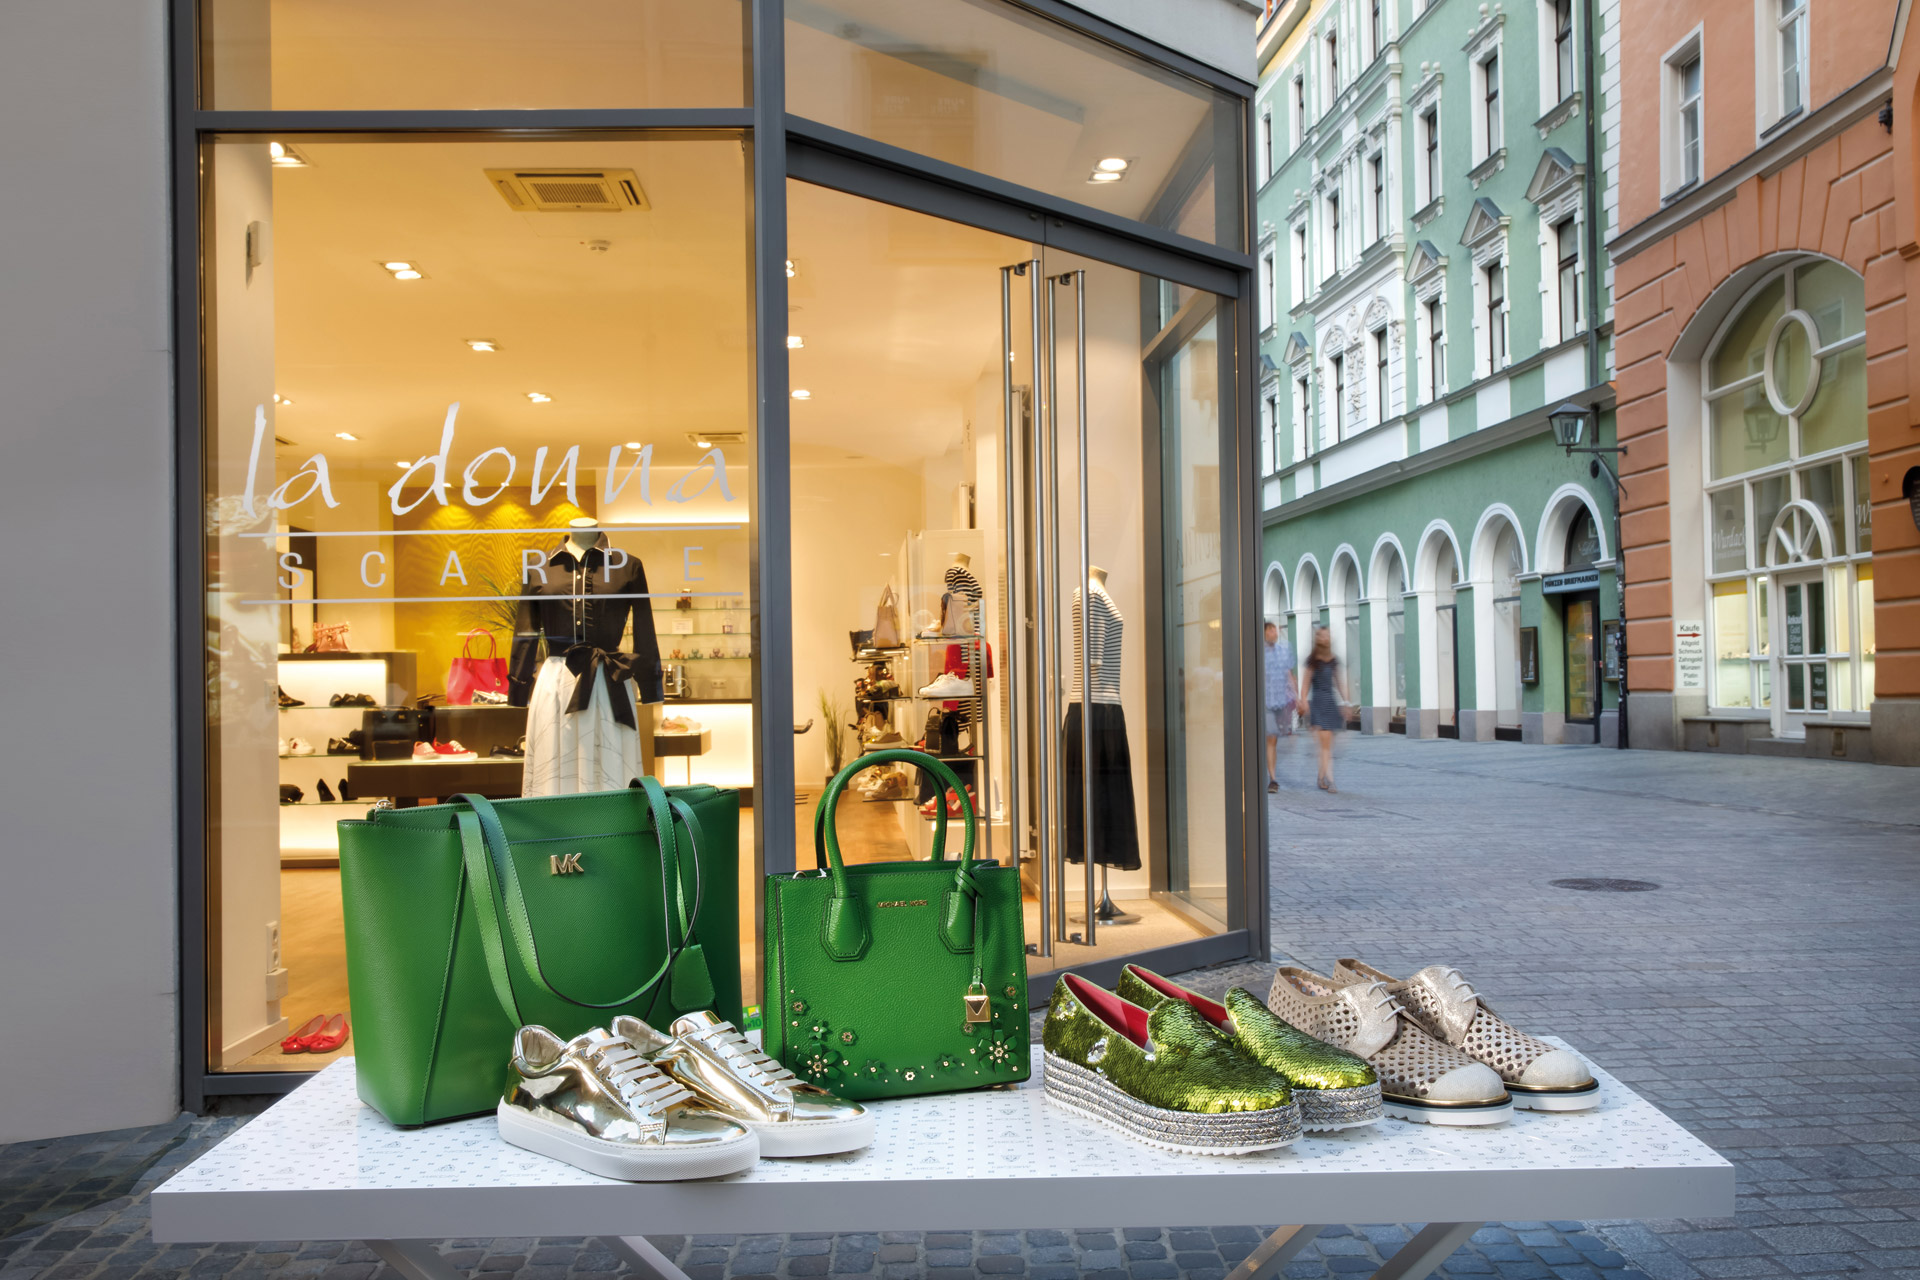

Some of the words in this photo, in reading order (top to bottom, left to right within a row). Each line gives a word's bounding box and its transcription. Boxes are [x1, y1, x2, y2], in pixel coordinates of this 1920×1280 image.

[243, 403, 341, 519] la
[388, 401, 736, 516] donna
[278, 546, 705, 589] SCARPE
[1679, 623, 1700, 632] Kaufe
[550, 852, 585, 874] MK
[877, 900, 907, 908] MICHAEL
[909, 899, 928, 907] KORS
